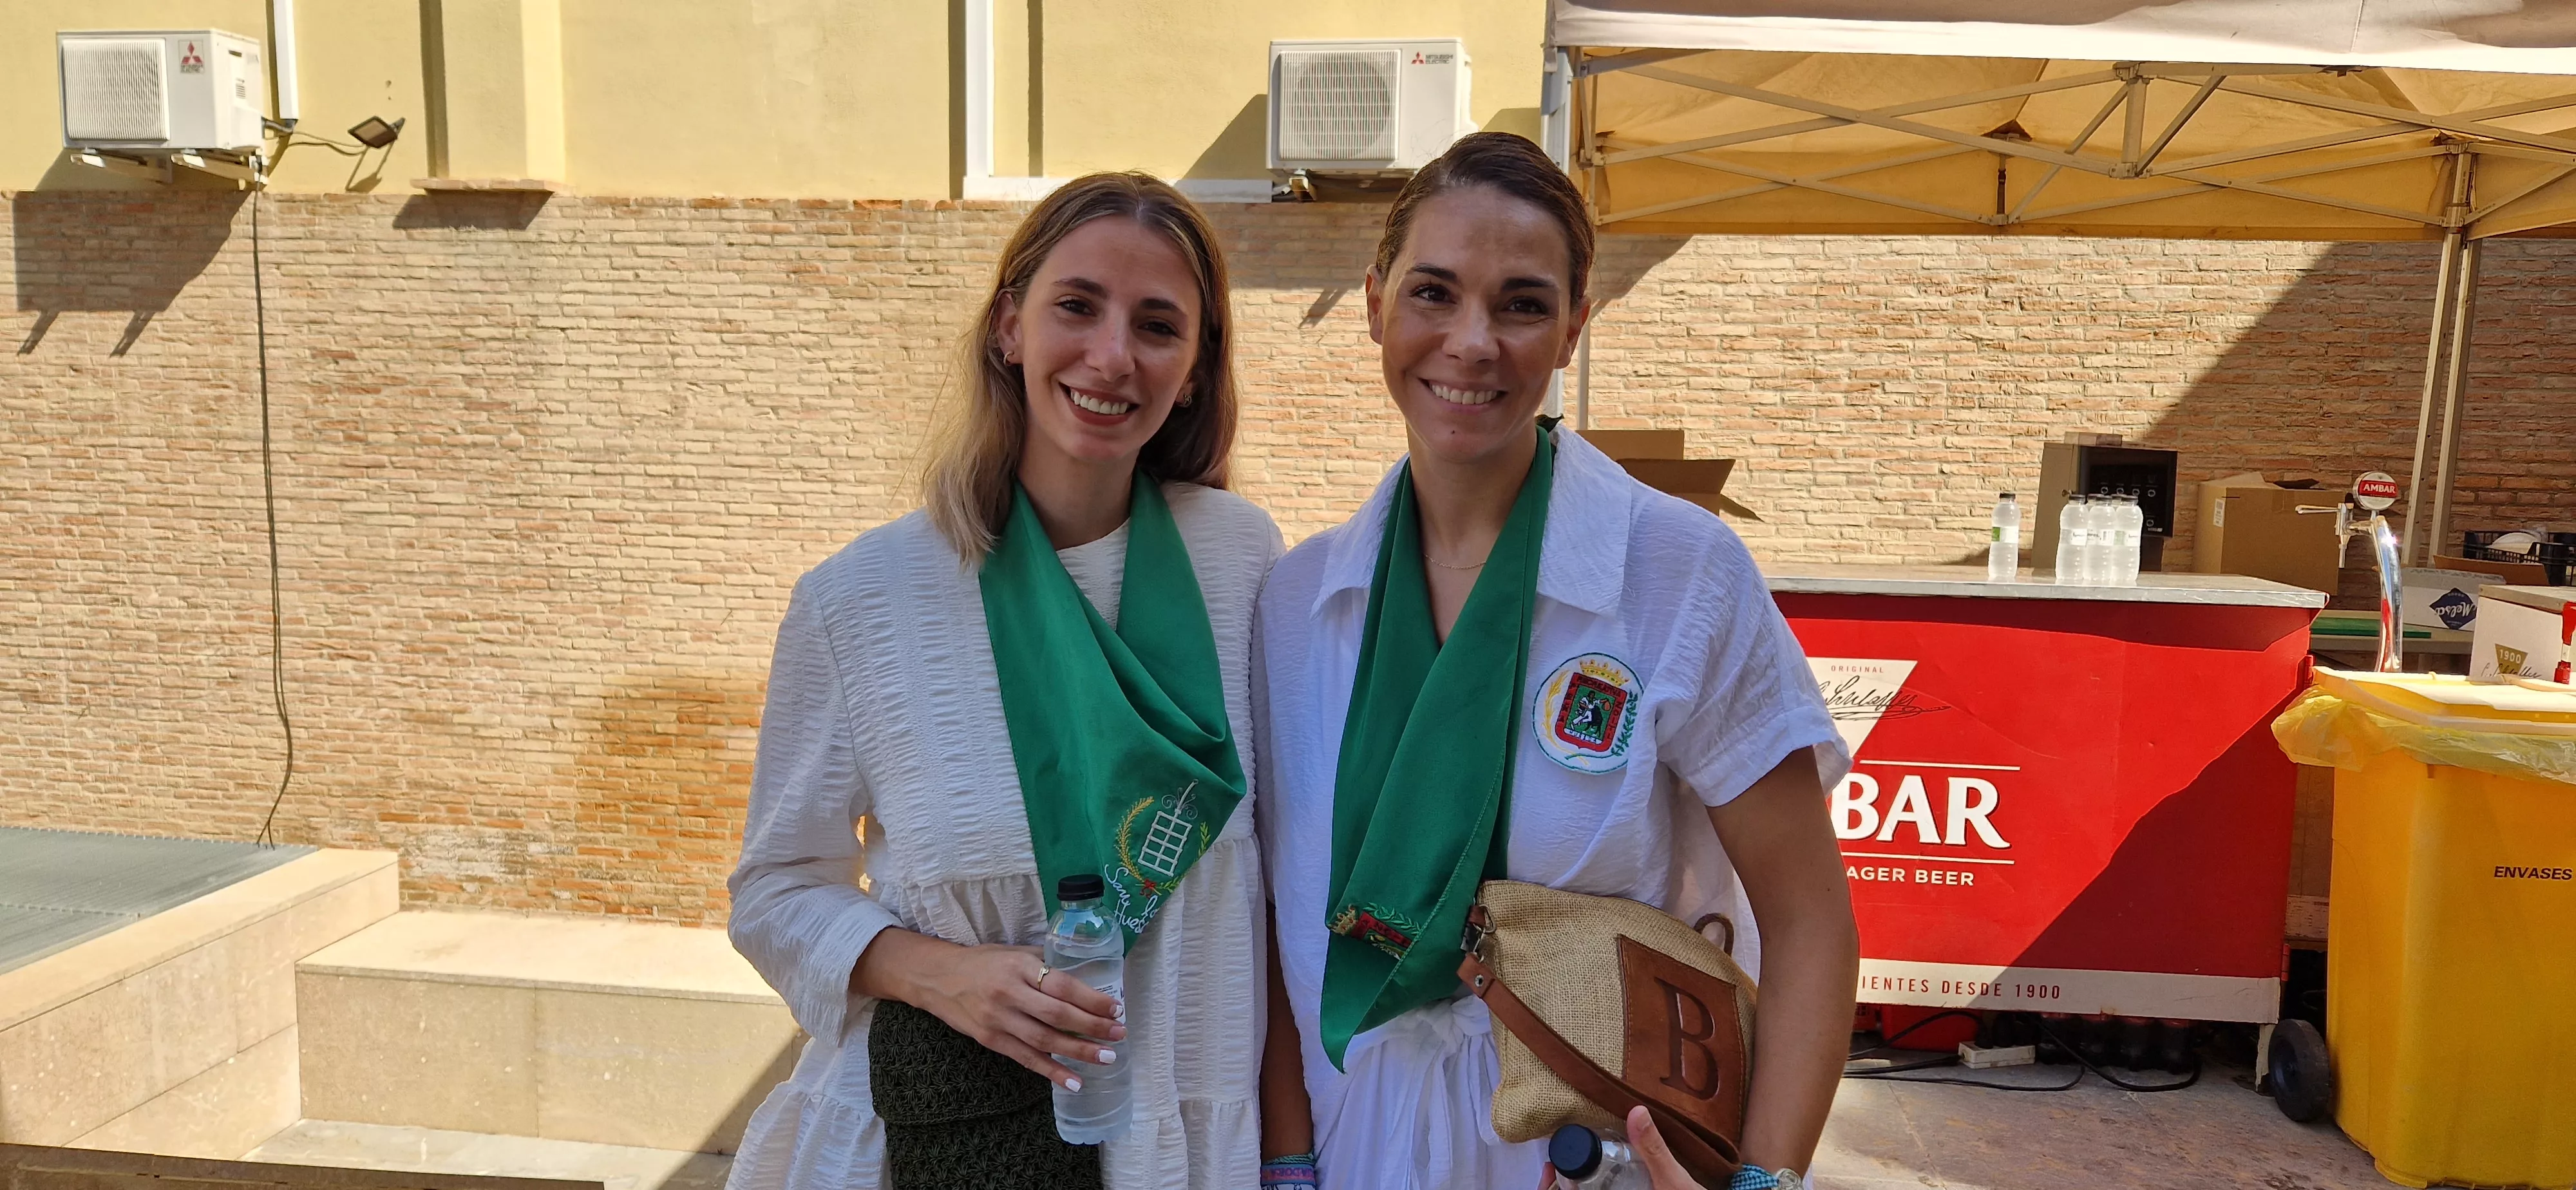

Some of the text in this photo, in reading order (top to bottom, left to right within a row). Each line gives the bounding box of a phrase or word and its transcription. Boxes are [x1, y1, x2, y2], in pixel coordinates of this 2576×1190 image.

[2363, 483, 2396, 494] AMBAR
[2499, 649, 2521, 664] 1900
[1846, 865, 1975, 886] AGER BEER
[2494, 865, 2573, 880] ENVASES
[1862, 975, 2061, 999] IENTES DESDE 1900
[1654, 976, 1721, 1101] B
